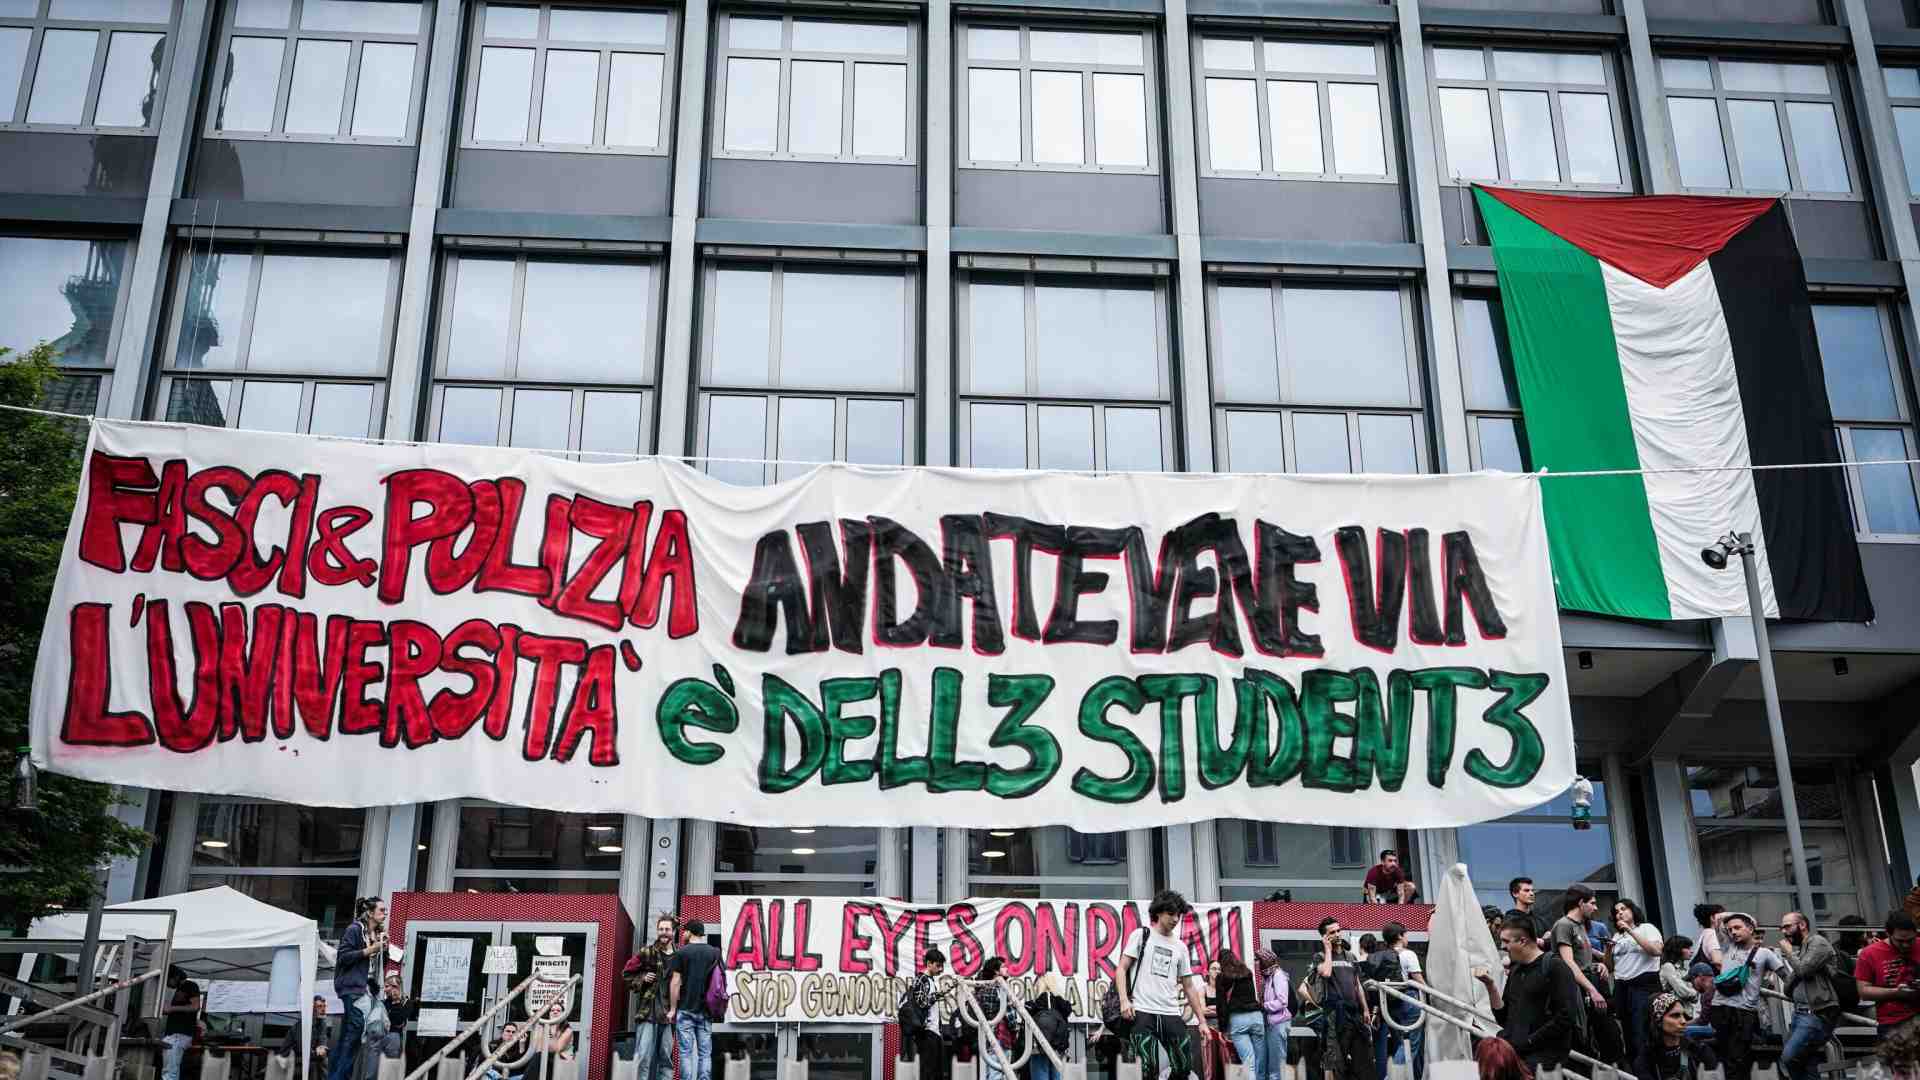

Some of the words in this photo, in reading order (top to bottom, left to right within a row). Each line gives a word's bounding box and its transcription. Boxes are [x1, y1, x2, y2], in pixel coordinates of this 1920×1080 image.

[79, 451, 320, 599] FASCI
[379, 467, 699, 639] POLIZIA
[732, 511, 1325, 659] ANDATEVENE
[1335, 525, 1508, 653] VIA
[758, 666, 1062, 796] DELL3
[1070, 666, 1549, 804] STUDENT3
[726, 898, 823, 972] ALL
[839, 901, 985, 978] EYES
[994, 901, 1080, 977] ON
[731, 971, 797, 1019] STOP
